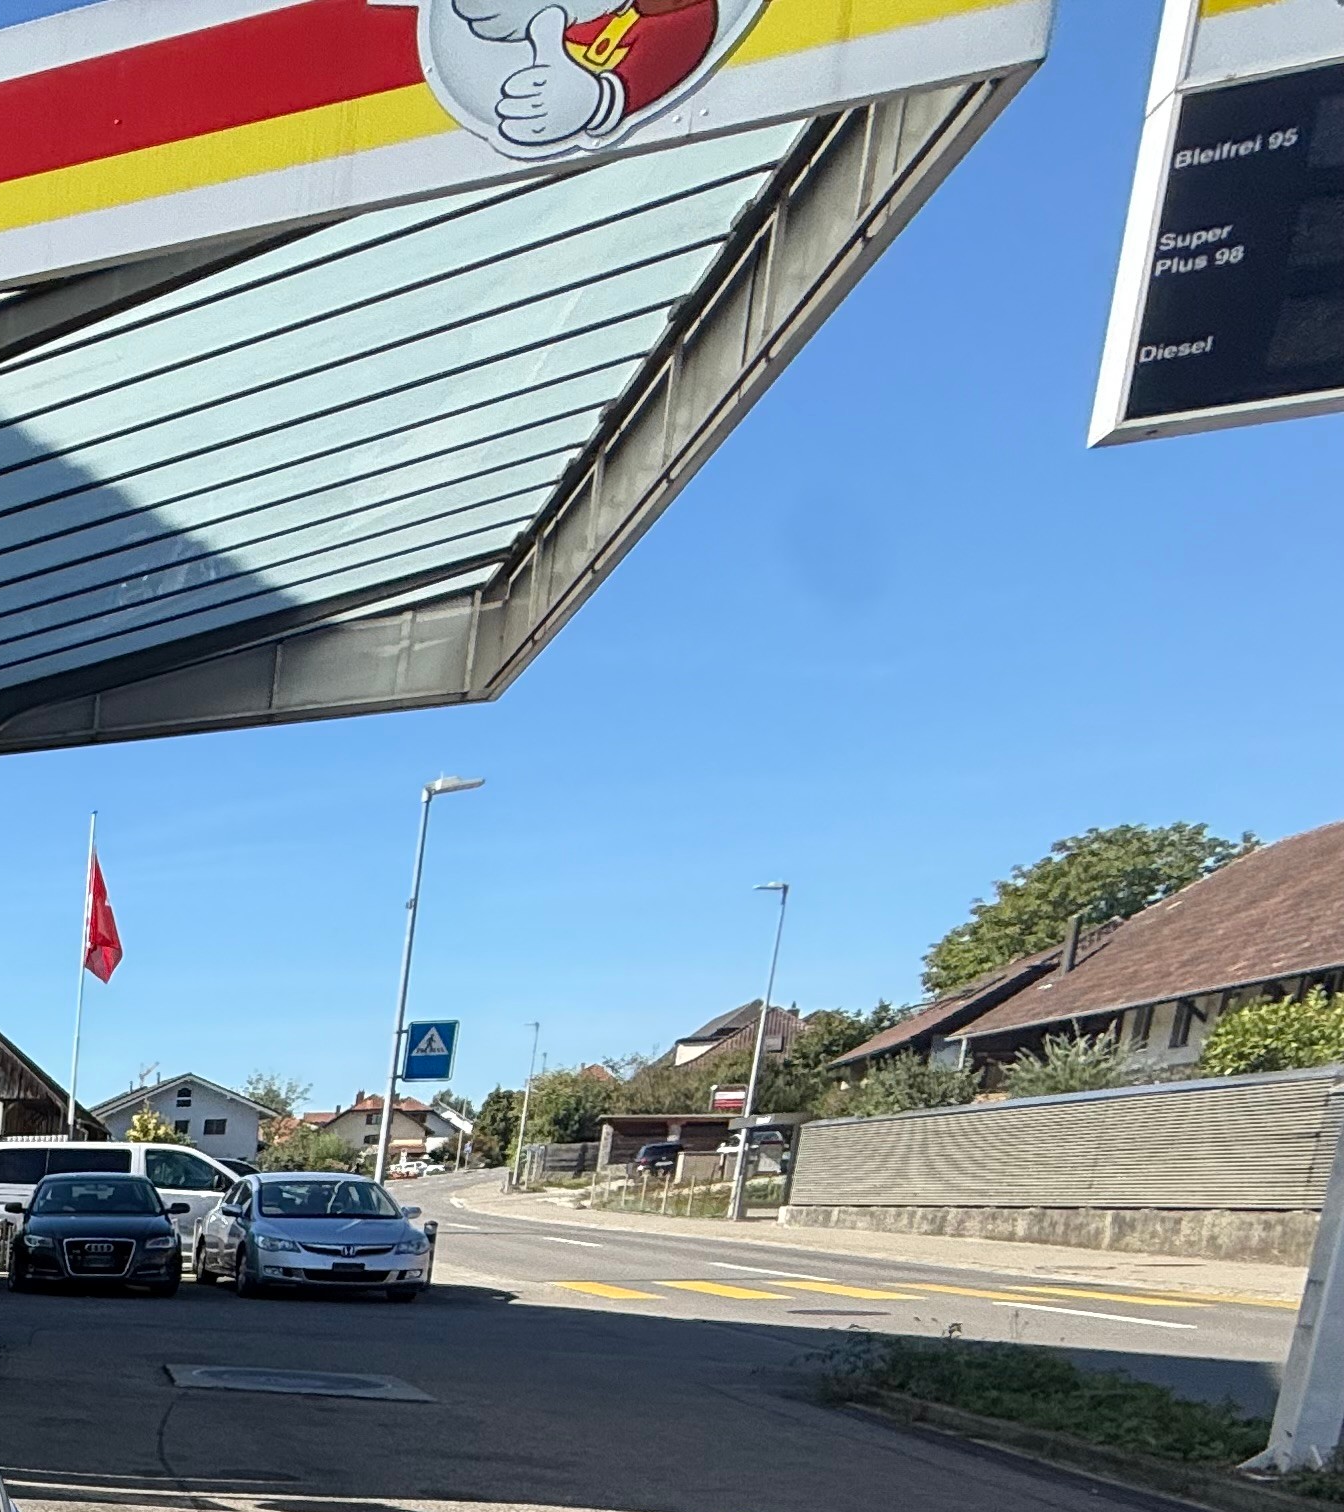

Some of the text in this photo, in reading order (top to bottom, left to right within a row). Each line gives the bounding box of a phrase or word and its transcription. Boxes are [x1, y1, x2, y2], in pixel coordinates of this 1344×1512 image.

[1174, 127, 1298, 169] Bleifrei 95
[1159, 224, 1234, 251] Super
[1154, 245, 1245, 277] Plus 98
[1138, 335, 1214, 363] Diesel
